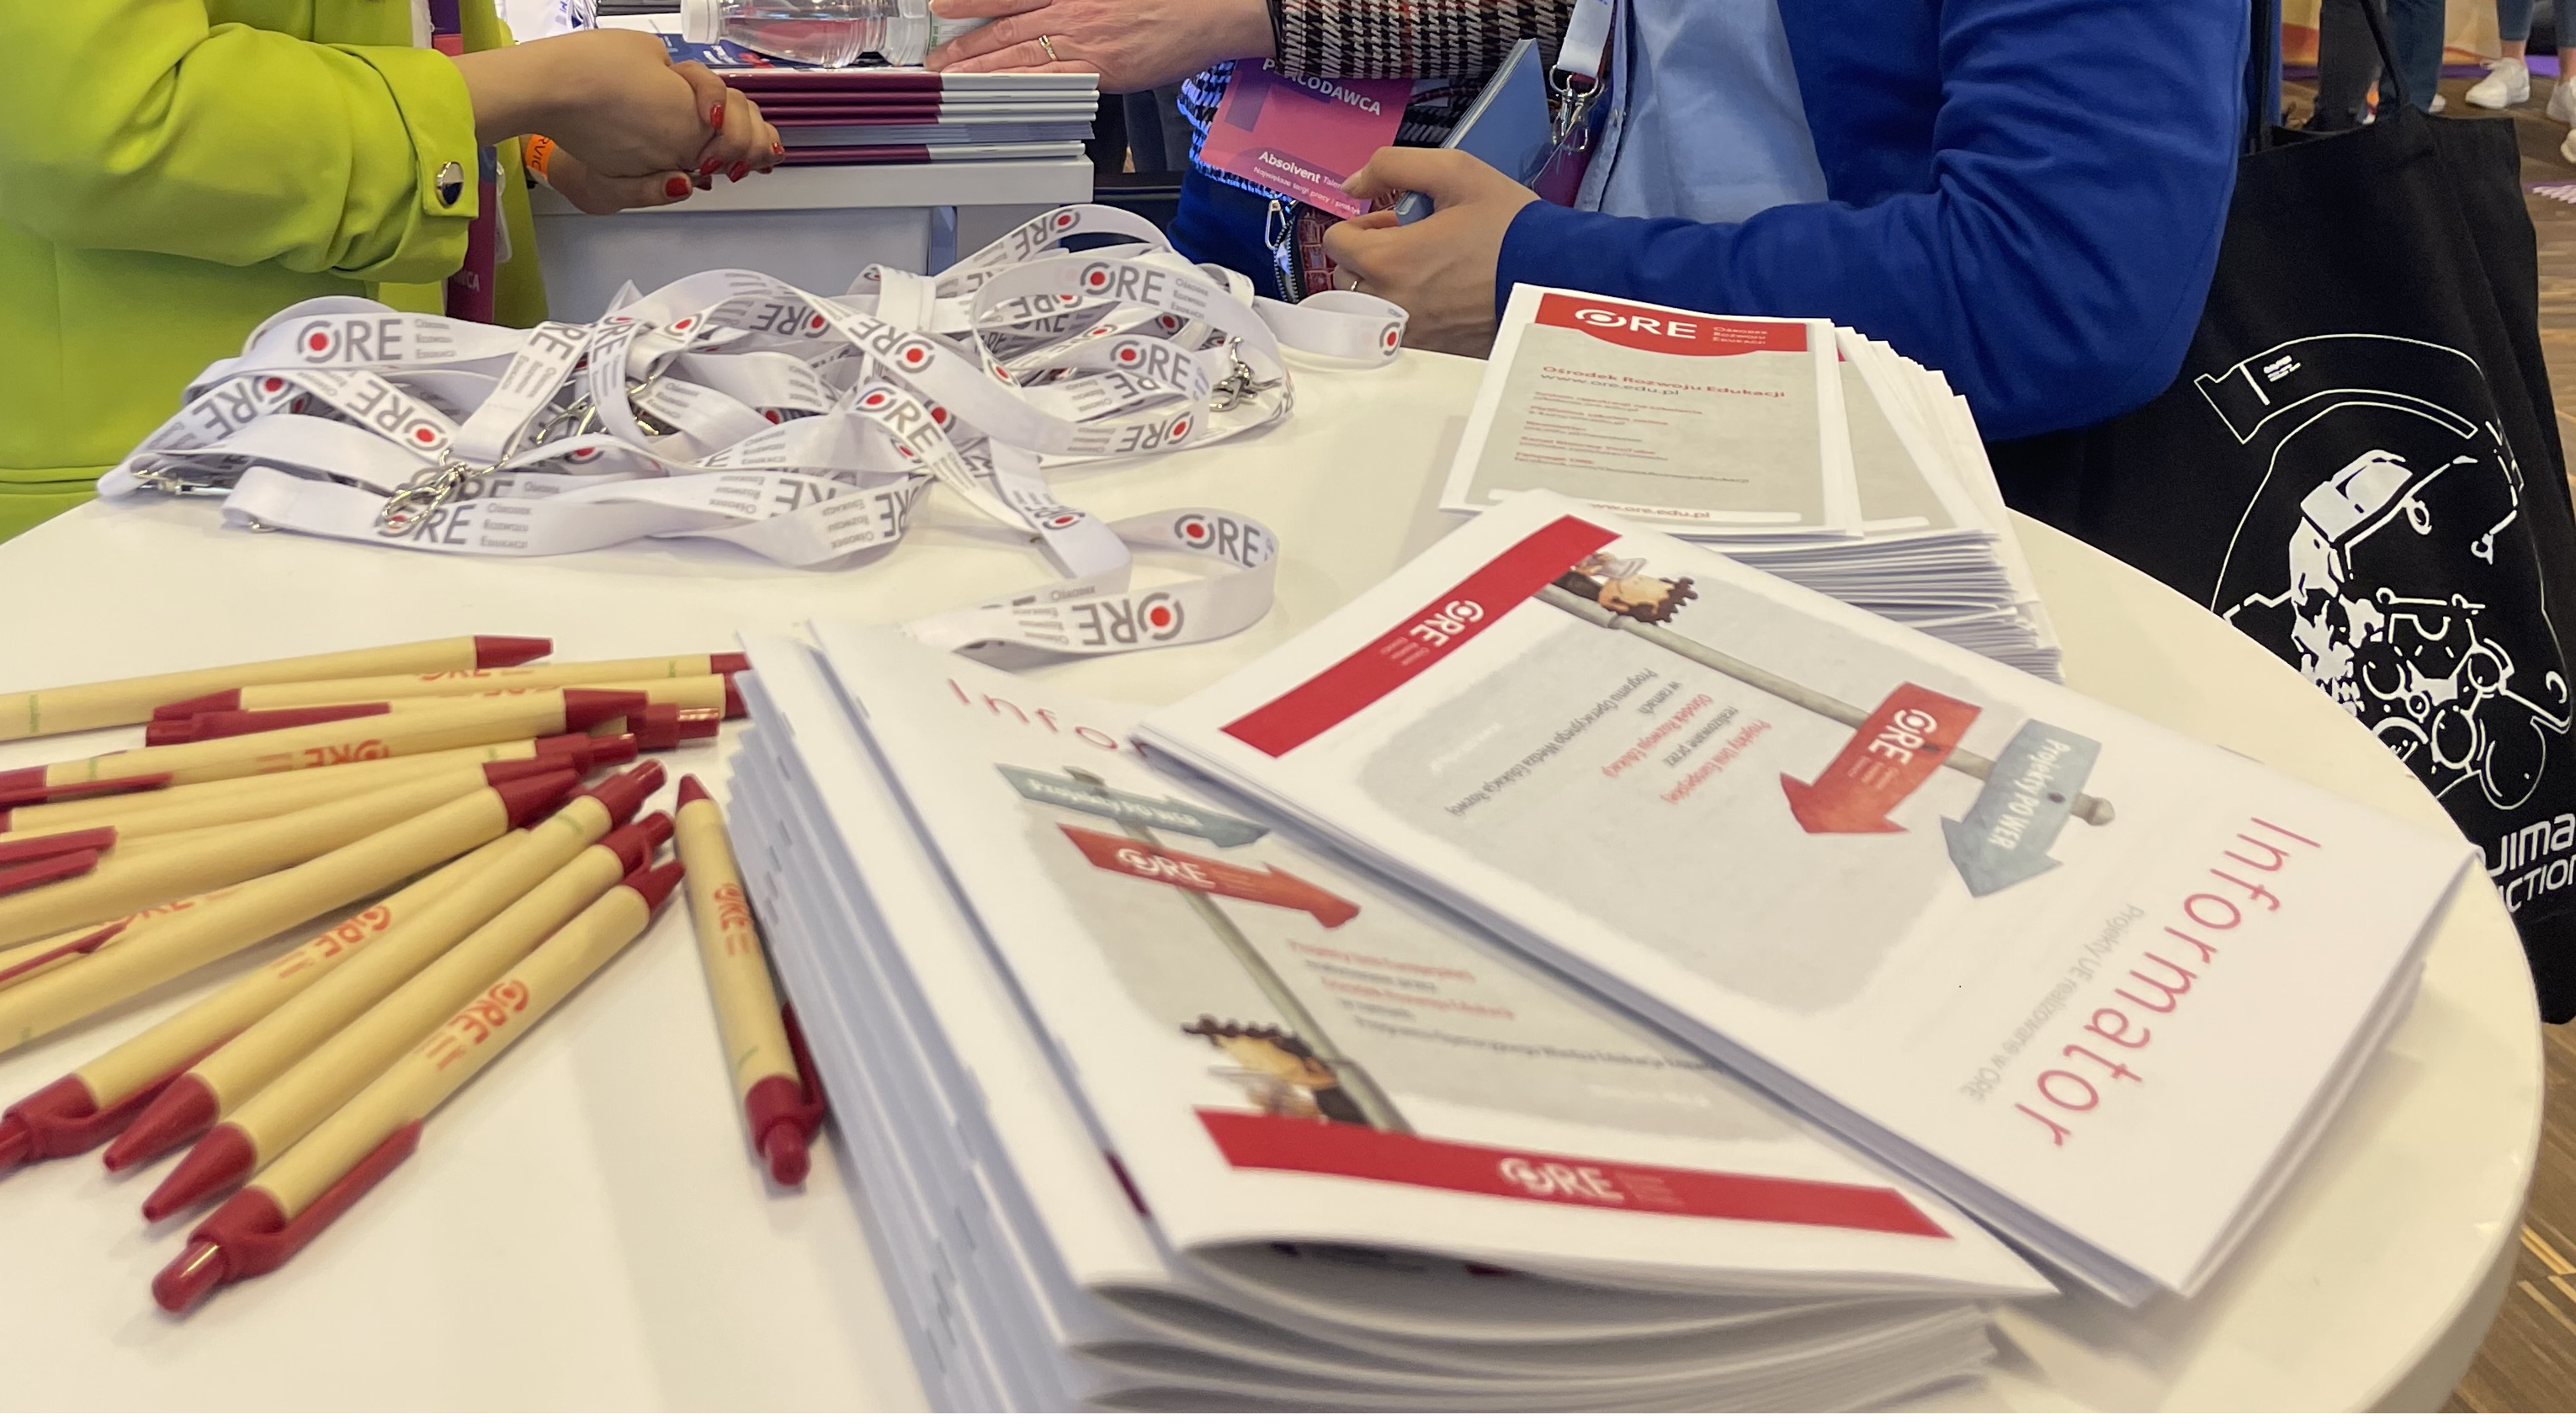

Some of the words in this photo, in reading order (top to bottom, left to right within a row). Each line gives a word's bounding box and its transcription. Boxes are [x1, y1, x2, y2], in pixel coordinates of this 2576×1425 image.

[1262, 58, 1381, 115] PCODAWCA
[1258, 152, 1321, 183] Absolvent
[1323, 176, 1342, 189] Talen
[1293, 183, 1309, 194] targi
[1310, 190, 1330, 203] pracy
[1336, 201, 1361, 215] praktyk
[1012, 210, 1081, 260] ORE
[1081, 262, 1167, 306] ORE
[298, 319, 403, 364] ORE
[847, 316, 937, 375] ORE
[1575, 309, 1697, 338] ORE
[1109, 339, 1192, 391] ORE
[1540, 374, 1679, 396] www.ore.edu.pl
[1543, 365, 1617, 381] Ośrodek
[1623, 376, 1702, 391] Rozwoju
[1707, 385, 1786, 398] Edukacji
[193, 376, 295, 441] ORE
[347, 380, 449, 453] ORE
[857, 385, 944, 454] ORE
[1116, 411, 1195, 453] ORE
[1590, 502, 1711, 518] ww.ore.edu.pl
[1175, 513, 1261, 568] ORE
[1071, 592, 1185, 647] ORE
[1410, 599, 1485, 646] ORE
[1617, 667, 1659, 705] Programu
[1638, 689, 1674, 715] ramach
[1553, 695, 1619, 746] Operacyjnego
[1686, 705, 1739, 747] realizowane
[1727, 720, 1771, 753] Projekty
[1869, 708, 1937, 767] ORE
[1664, 744, 1692, 768] przez
[2014, 738, 2071, 795] Projekty
[2008, 791, 2040, 816] PO
[1989, 813, 2030, 850] WER
[1116, 848, 1216, 888] ORE
[714, 882, 755, 933] ORE
[313, 904, 392, 958] ORE
[2086, 902, 2146, 962] Projekty
[2014, 816, 2321, 1147] Informator
[2069, 950, 2101, 986] UE
[449, 979, 530, 1045] ORE
[2001, 976, 2082, 1058] realizowane
[1993, 1051, 2010, 1068] w
[1961, 1067, 2002, 1105] ORE
[1500, 1157, 1624, 1203] ORE
